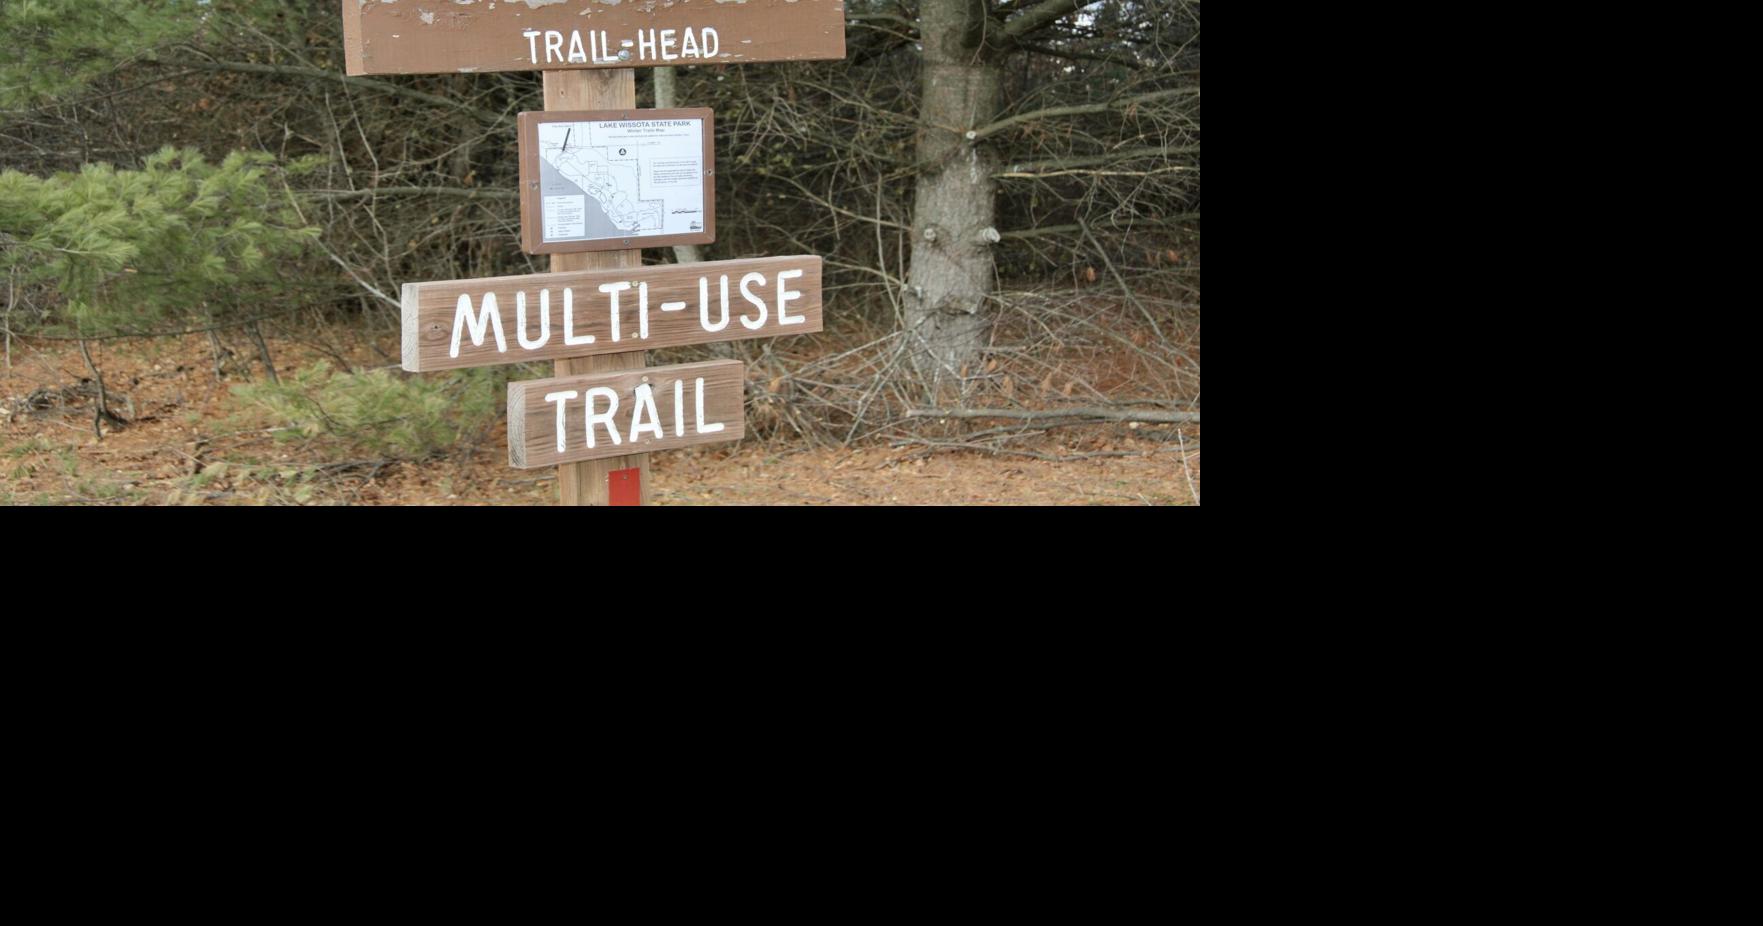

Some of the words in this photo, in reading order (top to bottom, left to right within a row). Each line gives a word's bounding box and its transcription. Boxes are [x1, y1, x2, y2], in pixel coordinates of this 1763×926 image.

[523, 26, 719, 64] TRAIL-HEAD
[449, 268, 806, 359] MULTI-USE
[544, 377, 725, 454] TRAIL
